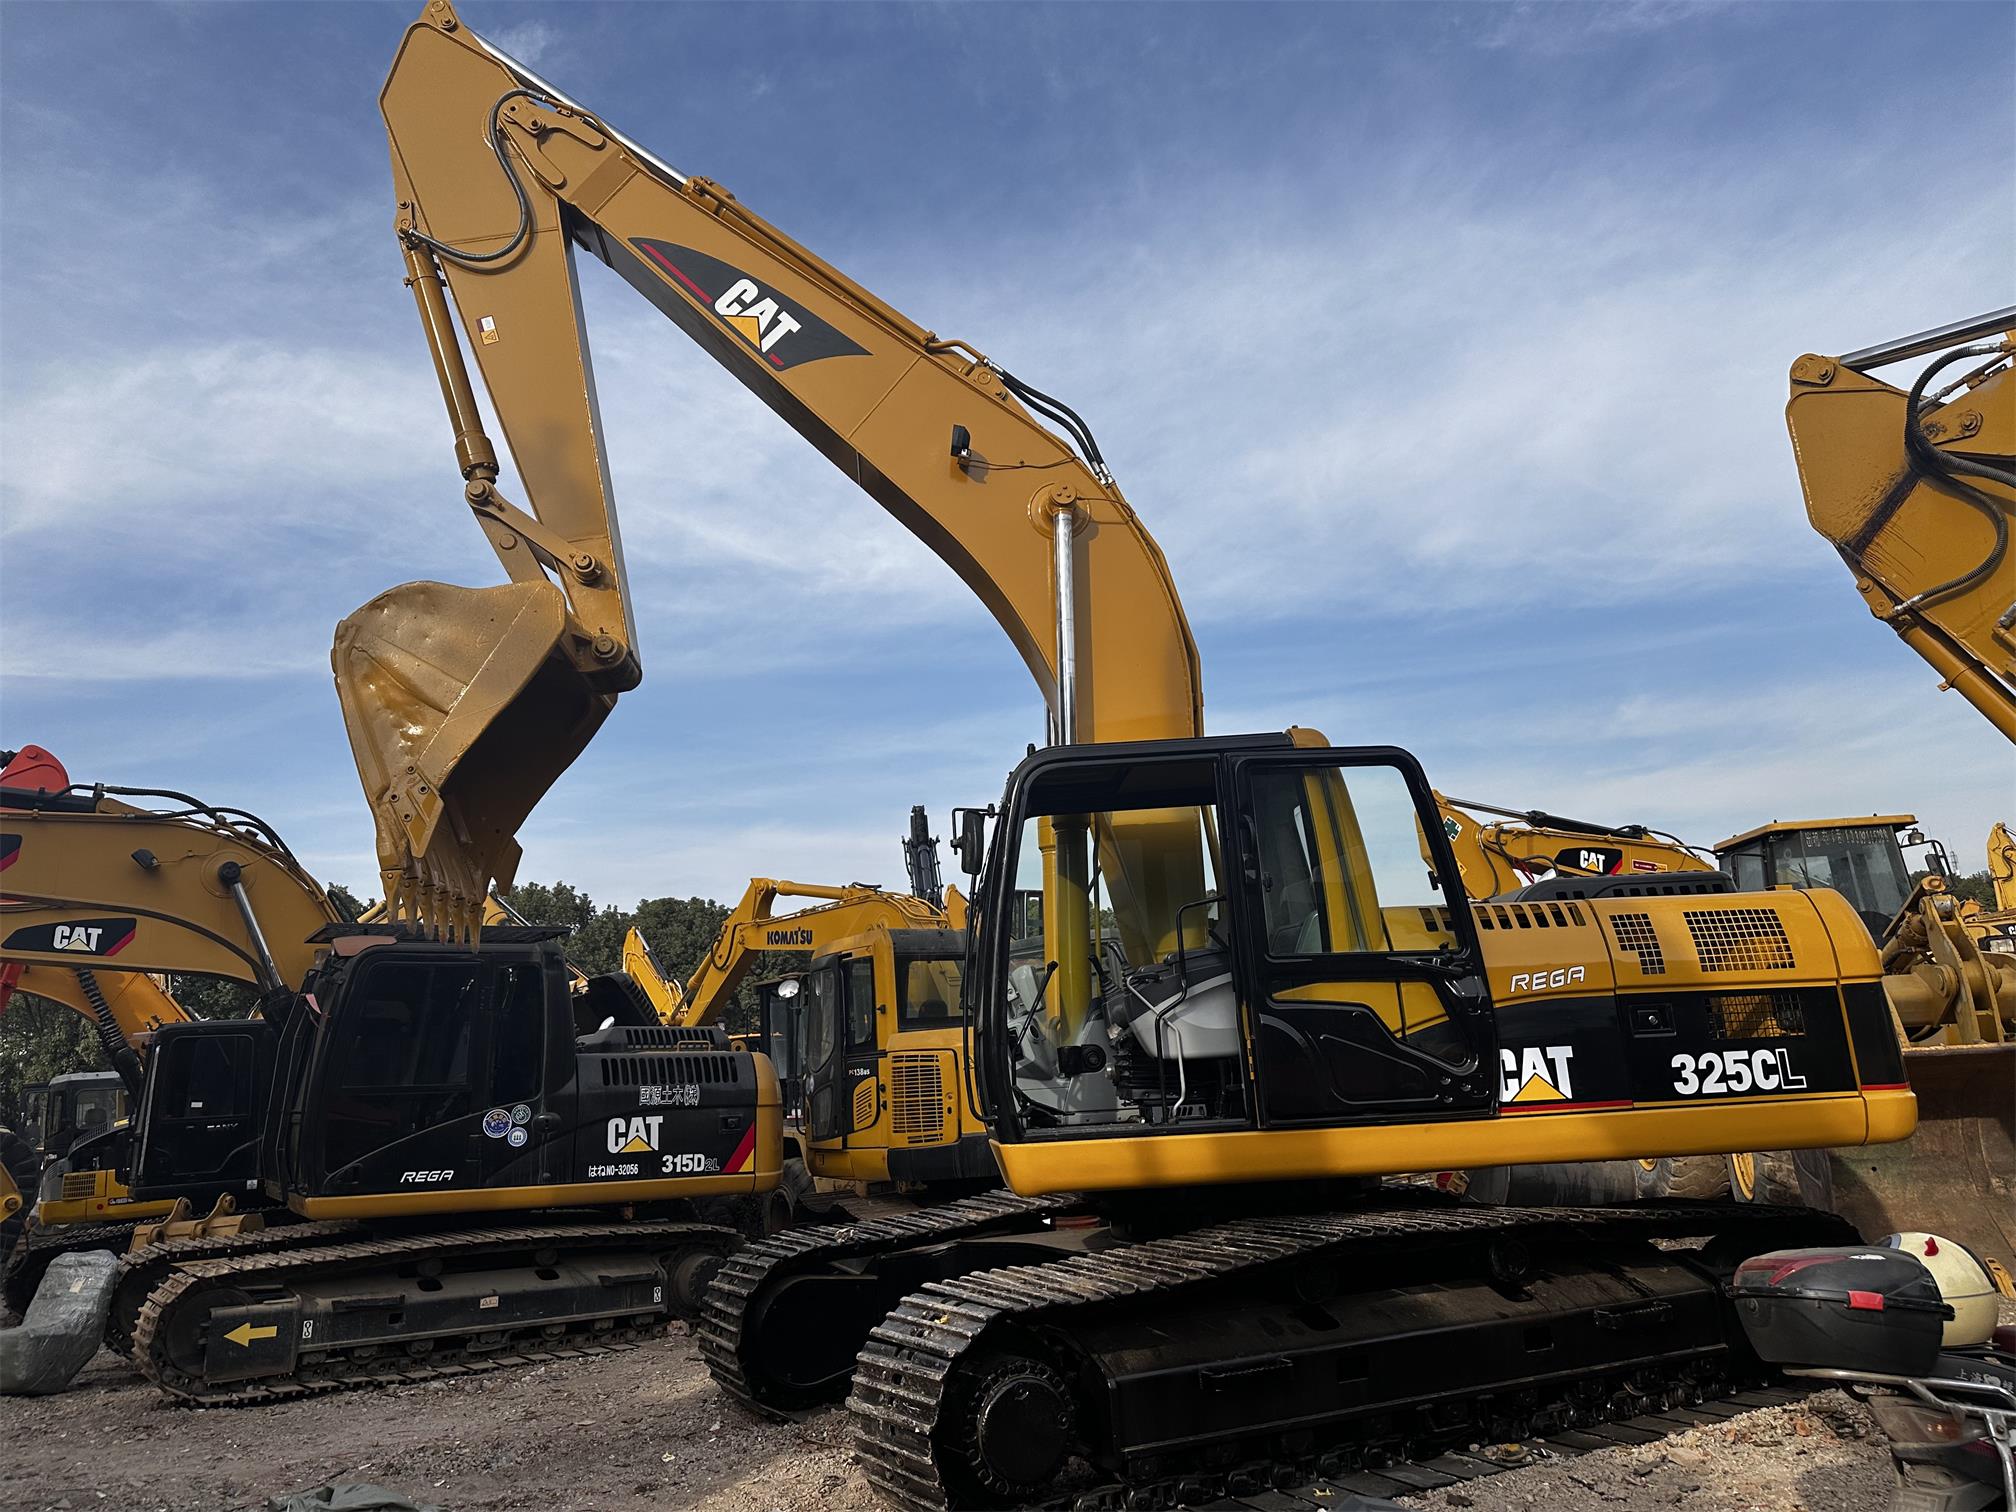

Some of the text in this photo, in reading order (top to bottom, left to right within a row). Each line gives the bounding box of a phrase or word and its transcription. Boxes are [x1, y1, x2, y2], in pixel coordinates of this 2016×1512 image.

[714, 278, 802, 353] CAT
[1580, 849, 1605, 873] CAT
[53, 924, 103, 951] CAT
[767, 930, 813, 945] KOMATSU
[1510, 965, 1585, 993] REGA
[1671, 1047, 1807, 1096] 325CL
[607, 1115, 664, 1154] CAT
[400, 1169, 454, 1184] REGA
